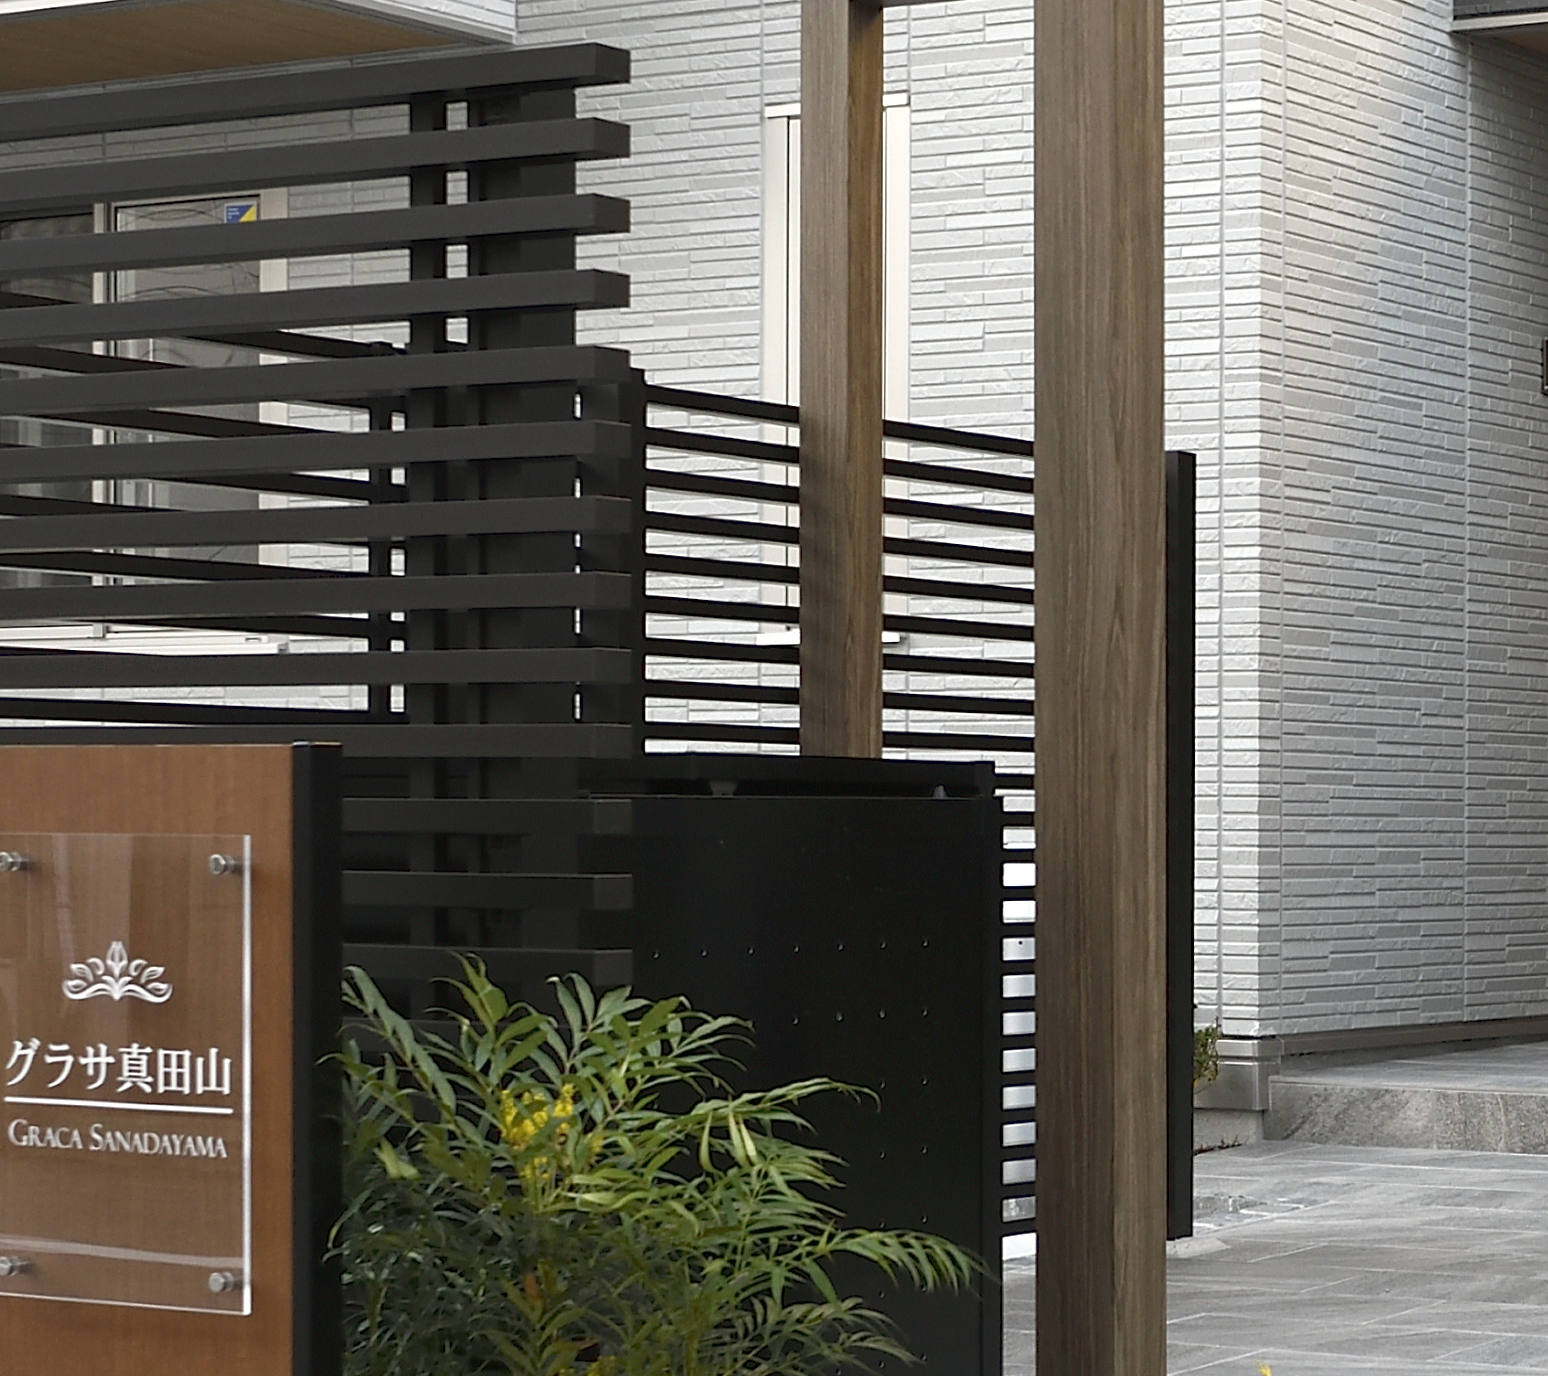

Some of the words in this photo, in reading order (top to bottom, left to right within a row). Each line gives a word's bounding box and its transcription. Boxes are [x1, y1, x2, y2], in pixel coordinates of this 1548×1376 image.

[5, 1037, 233, 1096] グラサ真田山
[7, 1118, 84, 1150] GRACA
[89, 1123, 229, 1159] SANADAYAMA
